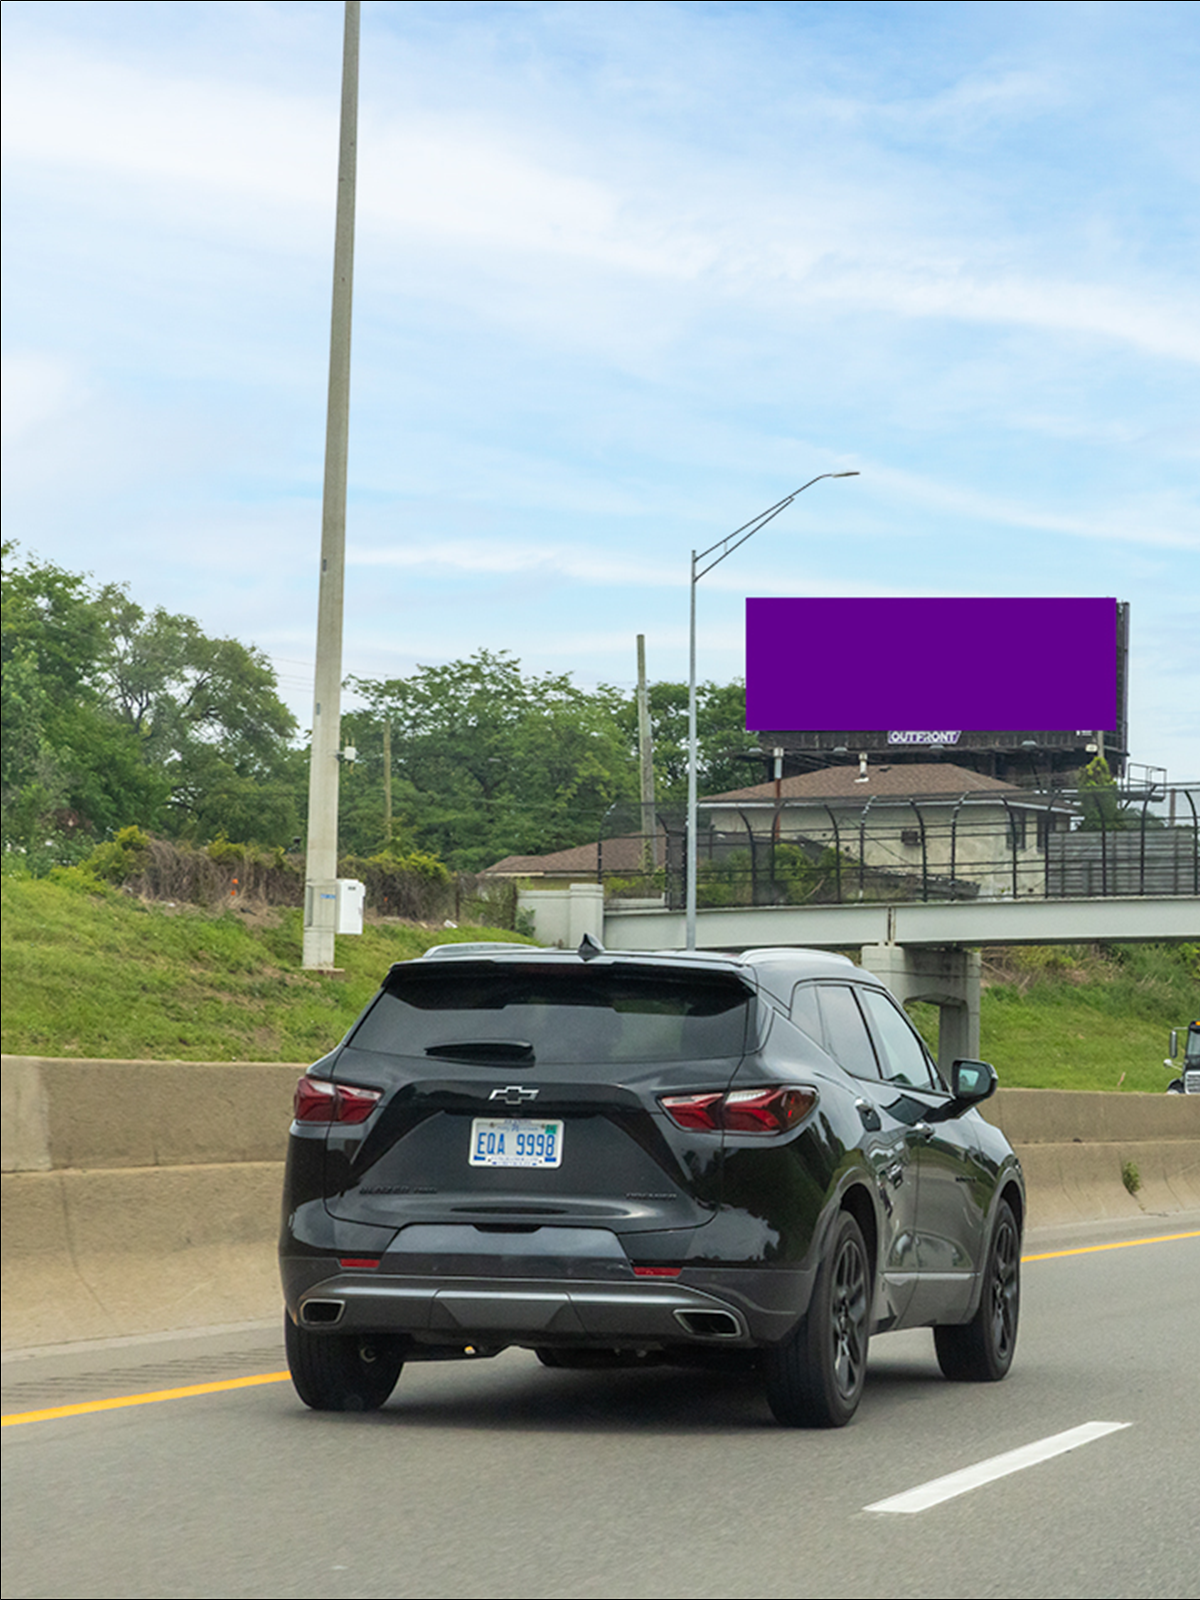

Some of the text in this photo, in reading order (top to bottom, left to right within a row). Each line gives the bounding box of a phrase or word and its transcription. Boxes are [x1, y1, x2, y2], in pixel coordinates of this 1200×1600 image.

[890, 731, 958, 743] OUTFRONT
[477, 1132, 556, 1157] EQA 9998
